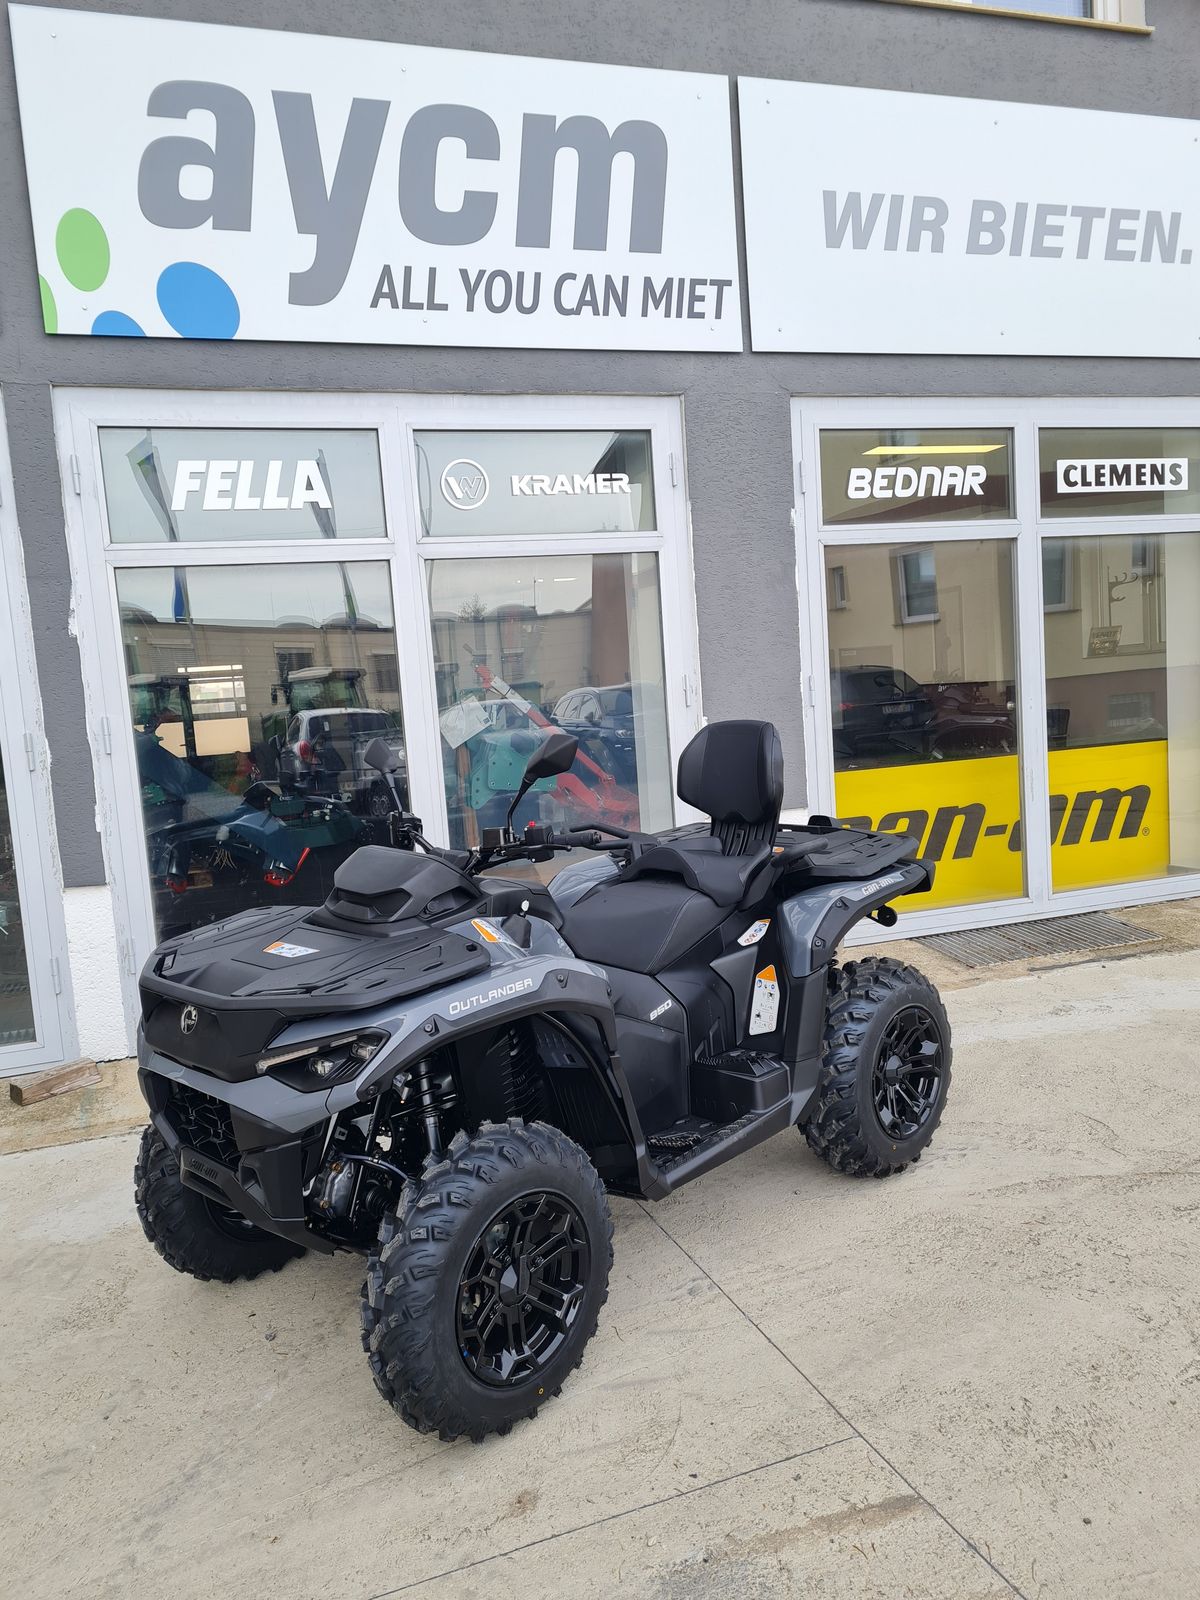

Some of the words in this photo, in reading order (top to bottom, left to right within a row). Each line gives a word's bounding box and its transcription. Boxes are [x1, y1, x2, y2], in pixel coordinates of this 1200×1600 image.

[138, 80, 669, 306] aycm
[823, 189, 948, 253] WIR
[965, 199, 1193, 264] BIETEN.
[370, 265, 448, 311] ALL
[459, 269, 541, 315] YOU
[554, 272, 629, 318] CAN
[641, 276, 732, 320] MIET
[171, 460, 332, 511] FELLA
[511, 473, 632, 496] KRAMER
[847, 465, 987, 499] BEDNAR
[1063, 463, 1183, 487] CLEMENS
[449, 978, 533, 1015] OUTLANDER
